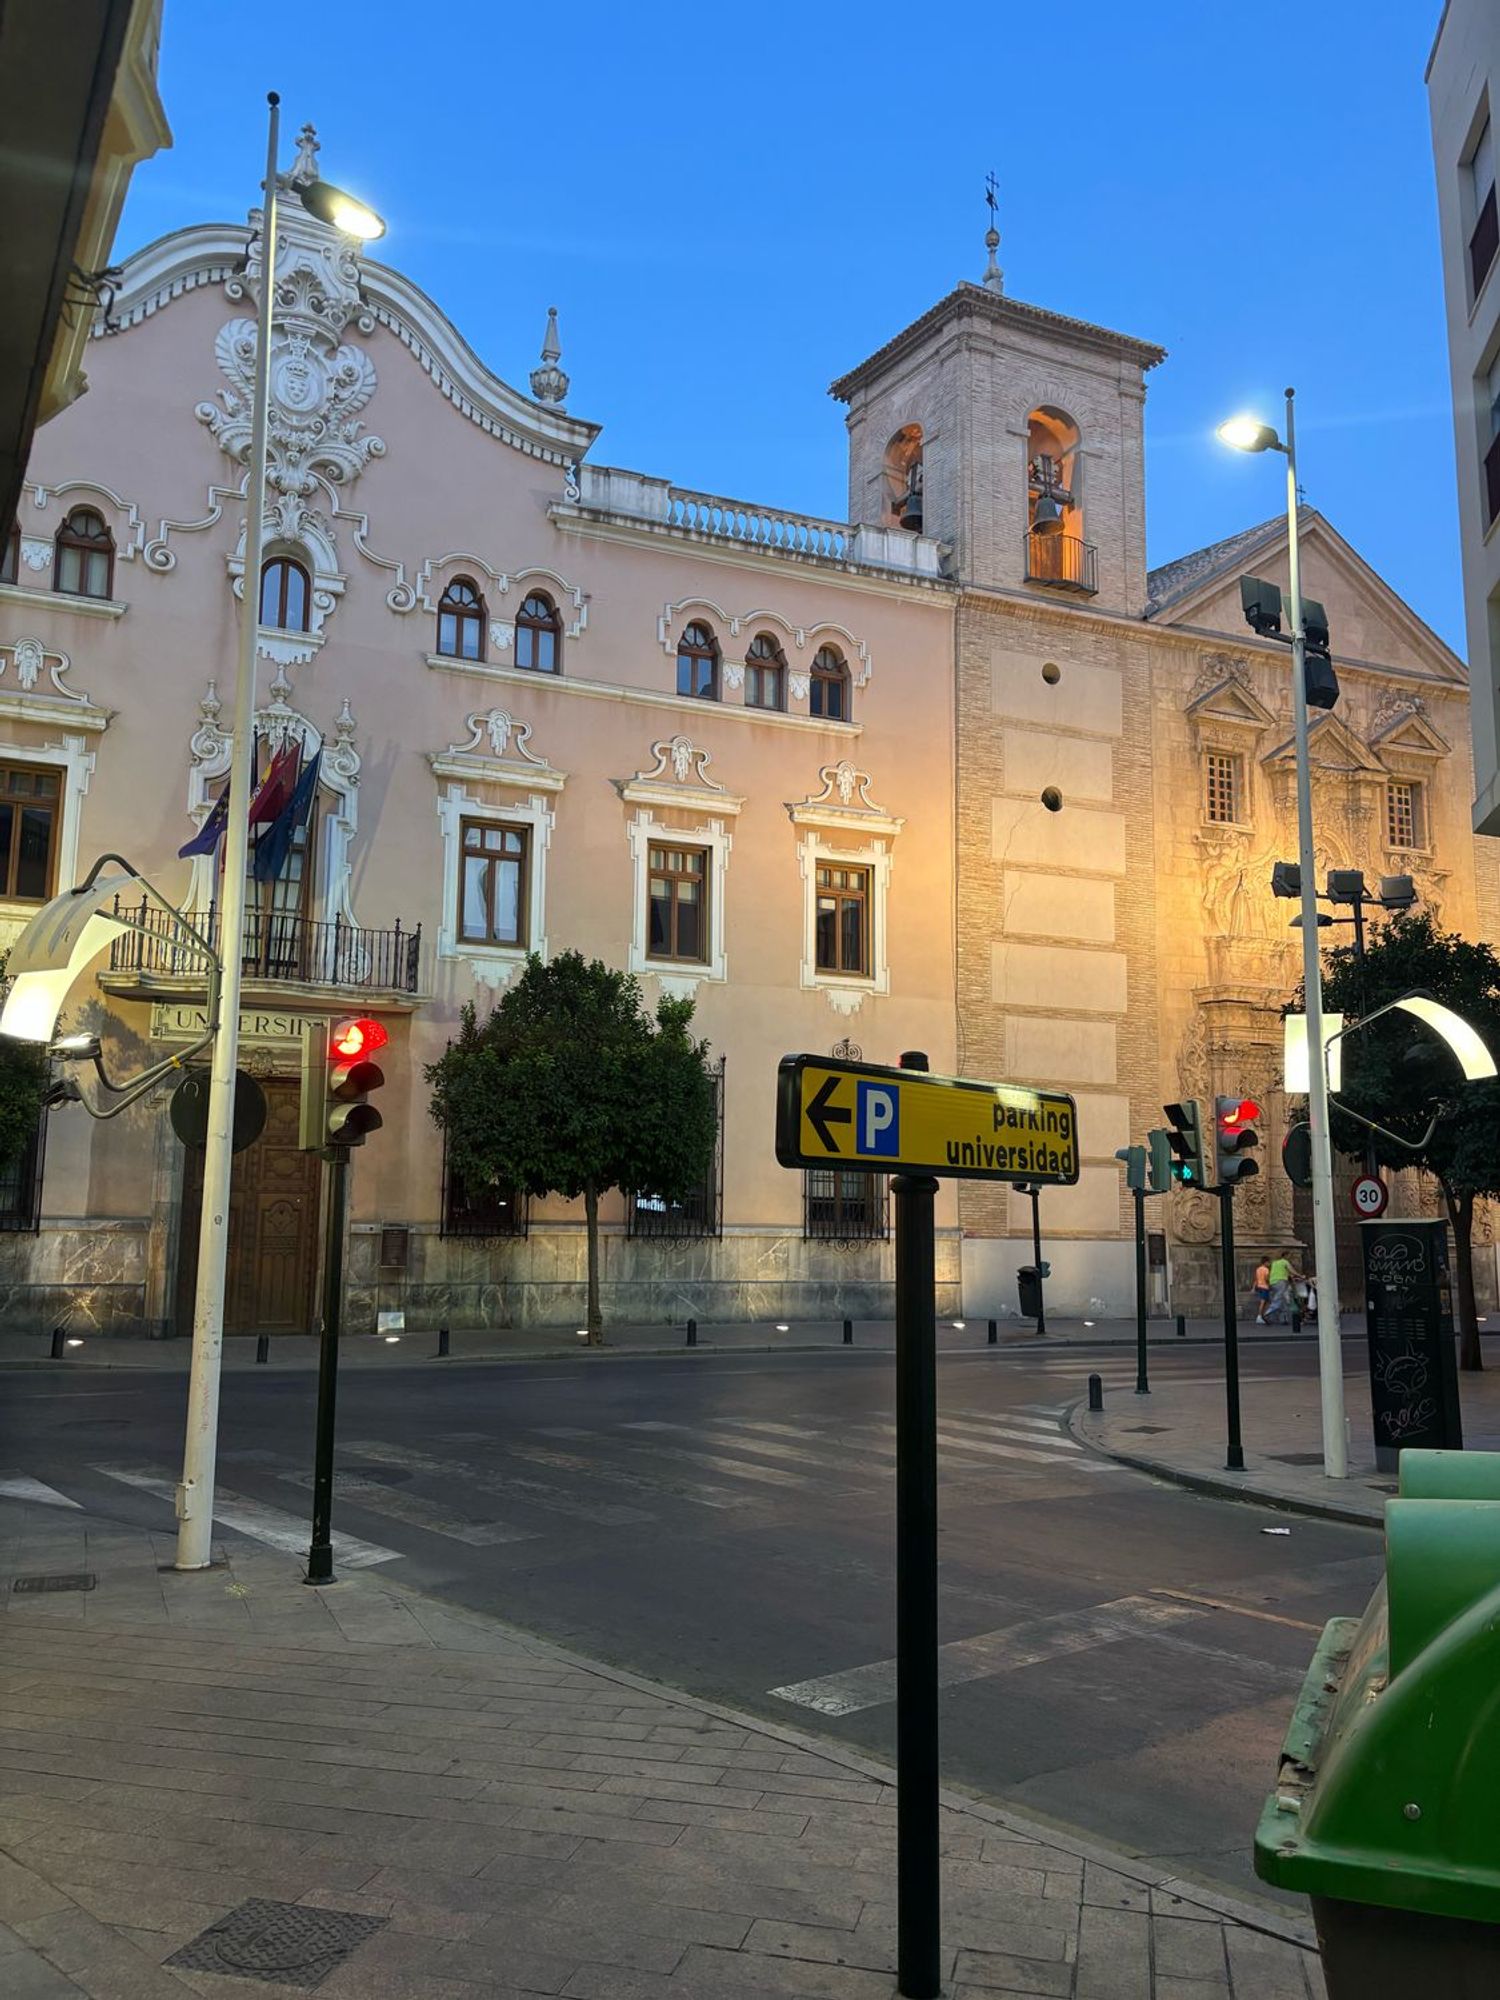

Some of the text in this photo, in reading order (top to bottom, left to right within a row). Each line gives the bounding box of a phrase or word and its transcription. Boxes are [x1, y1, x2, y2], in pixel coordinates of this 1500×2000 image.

[866, 1089, 893, 1149] P
[993, 1102, 1070, 1140] parking
[946, 1136, 1072, 1173] universidad
[1359, 1189, 1379, 1203] 30
